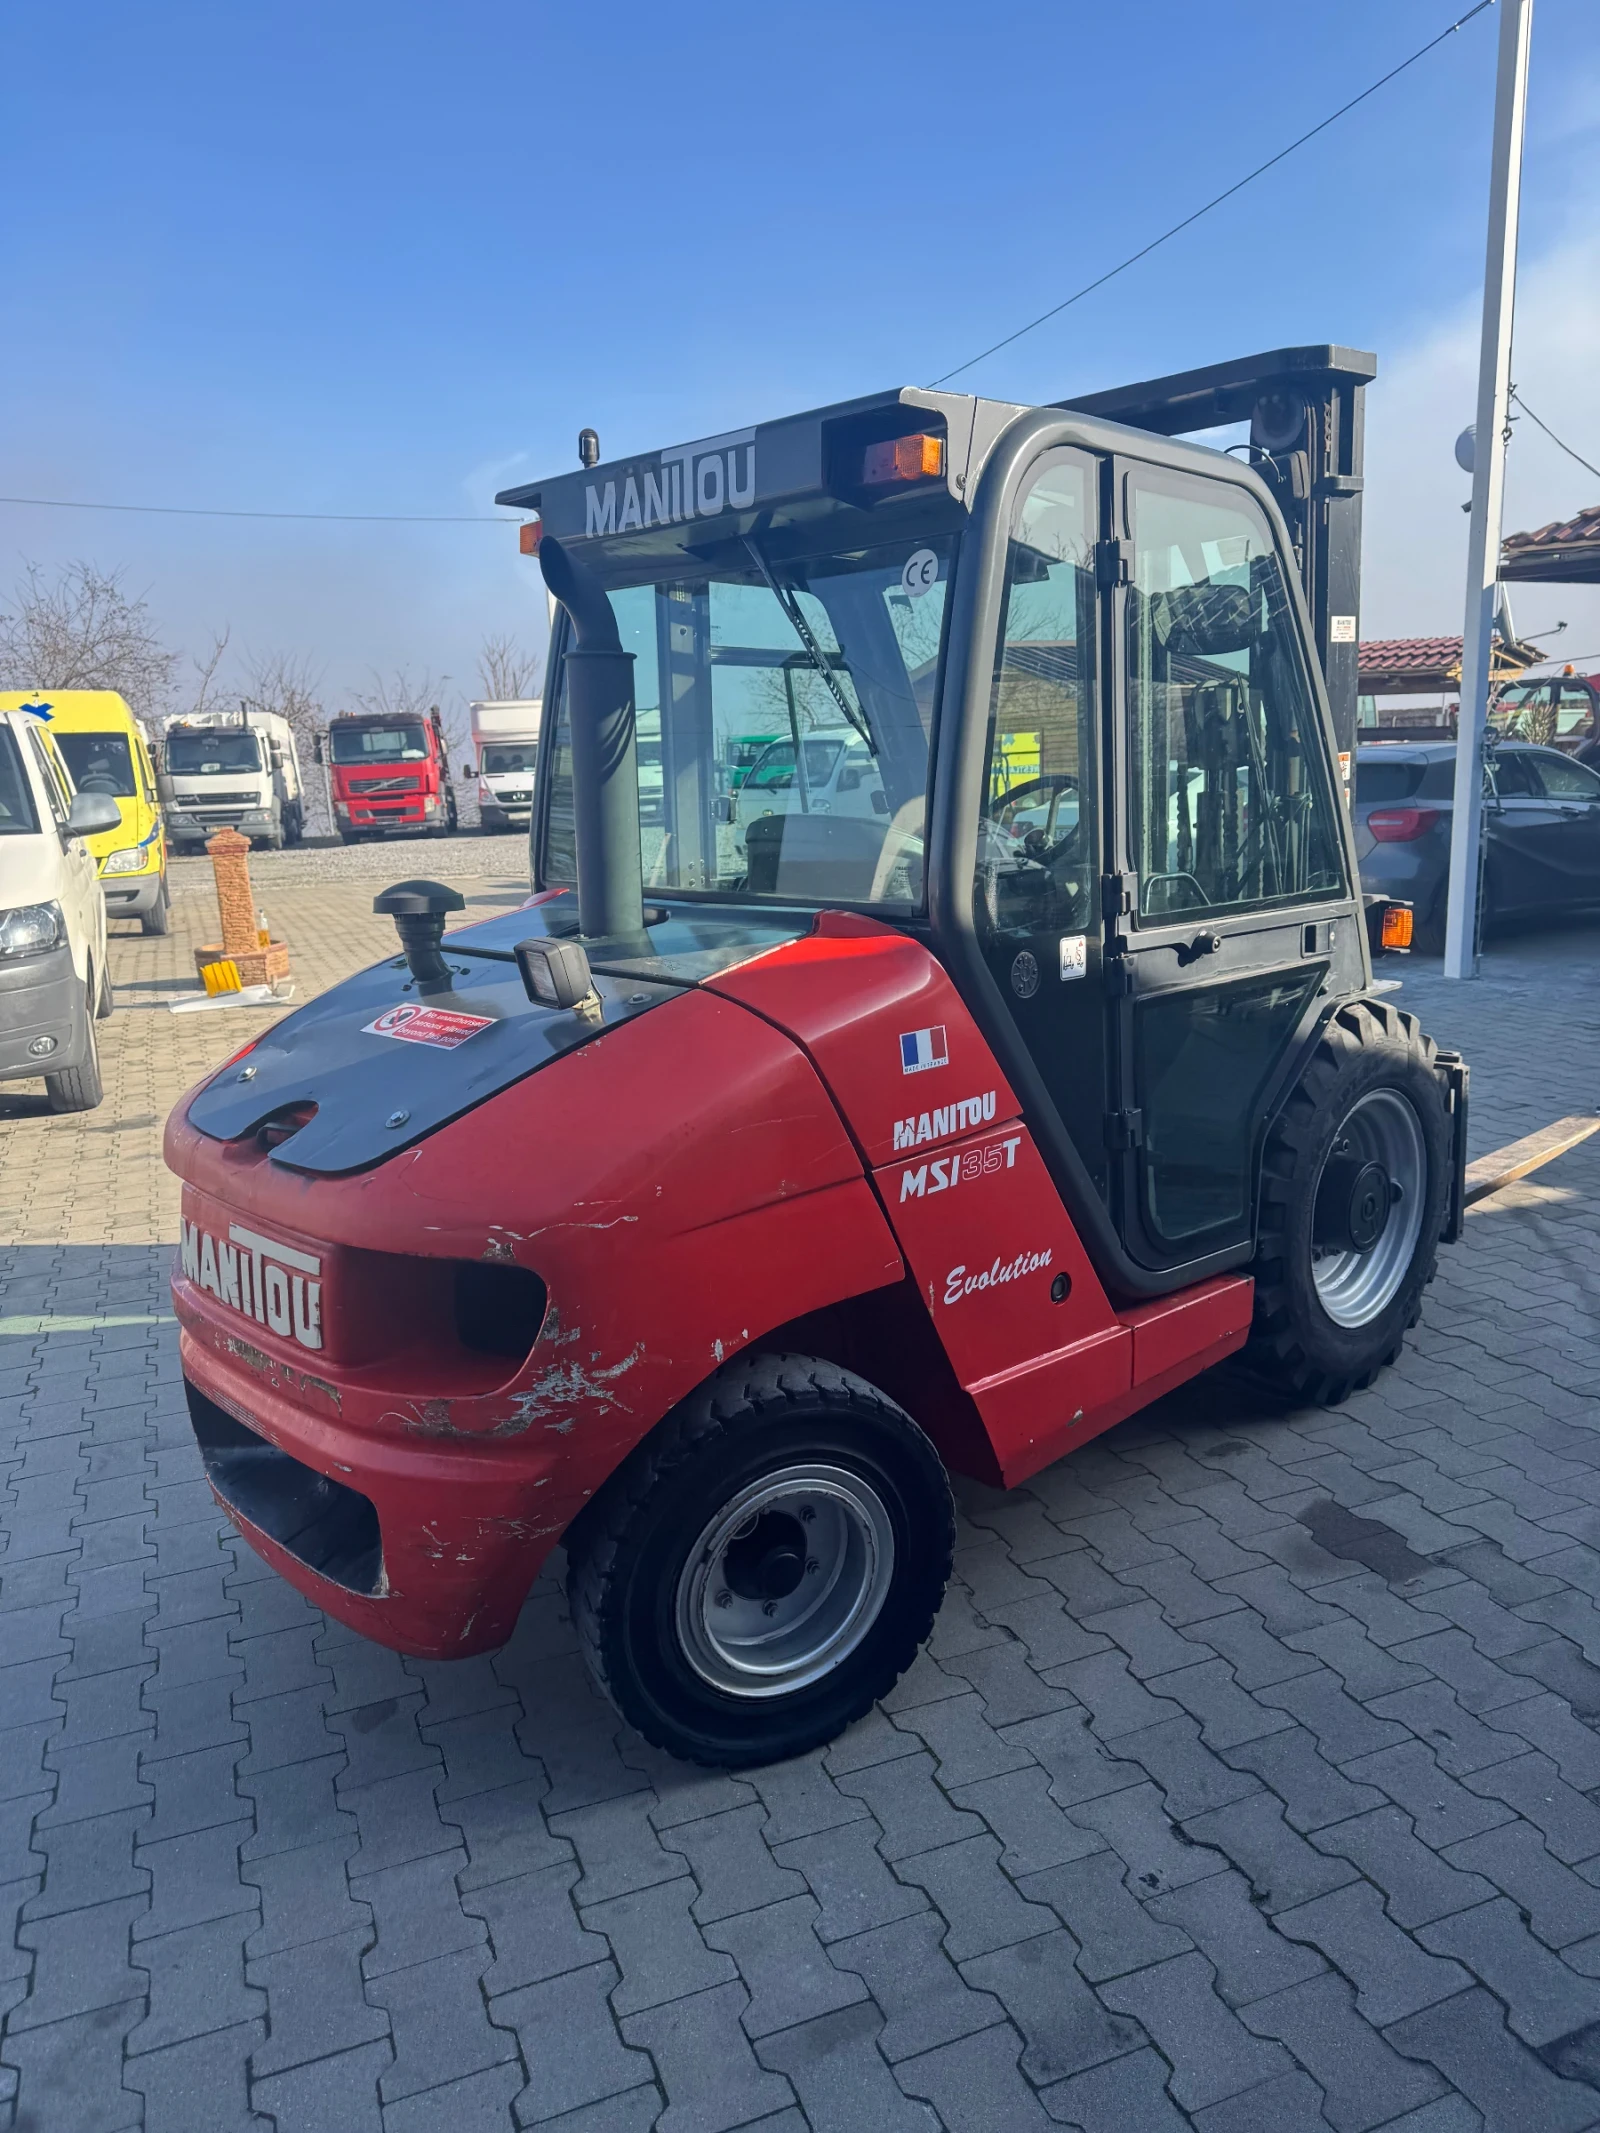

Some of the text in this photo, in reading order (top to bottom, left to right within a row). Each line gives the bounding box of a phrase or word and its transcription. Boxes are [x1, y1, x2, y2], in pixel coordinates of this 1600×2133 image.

[585, 426, 757, 538] MANITOU
[906, 559, 933, 587] CE
[412, 1020, 443, 1030] persons
[893, 1090, 996, 1150] MANITOU
[899, 1137, 1021, 1203] MSI35T
[180, 1215, 323, 1349] MANITOU
[944, 1248, 1052, 1305] Evolution
